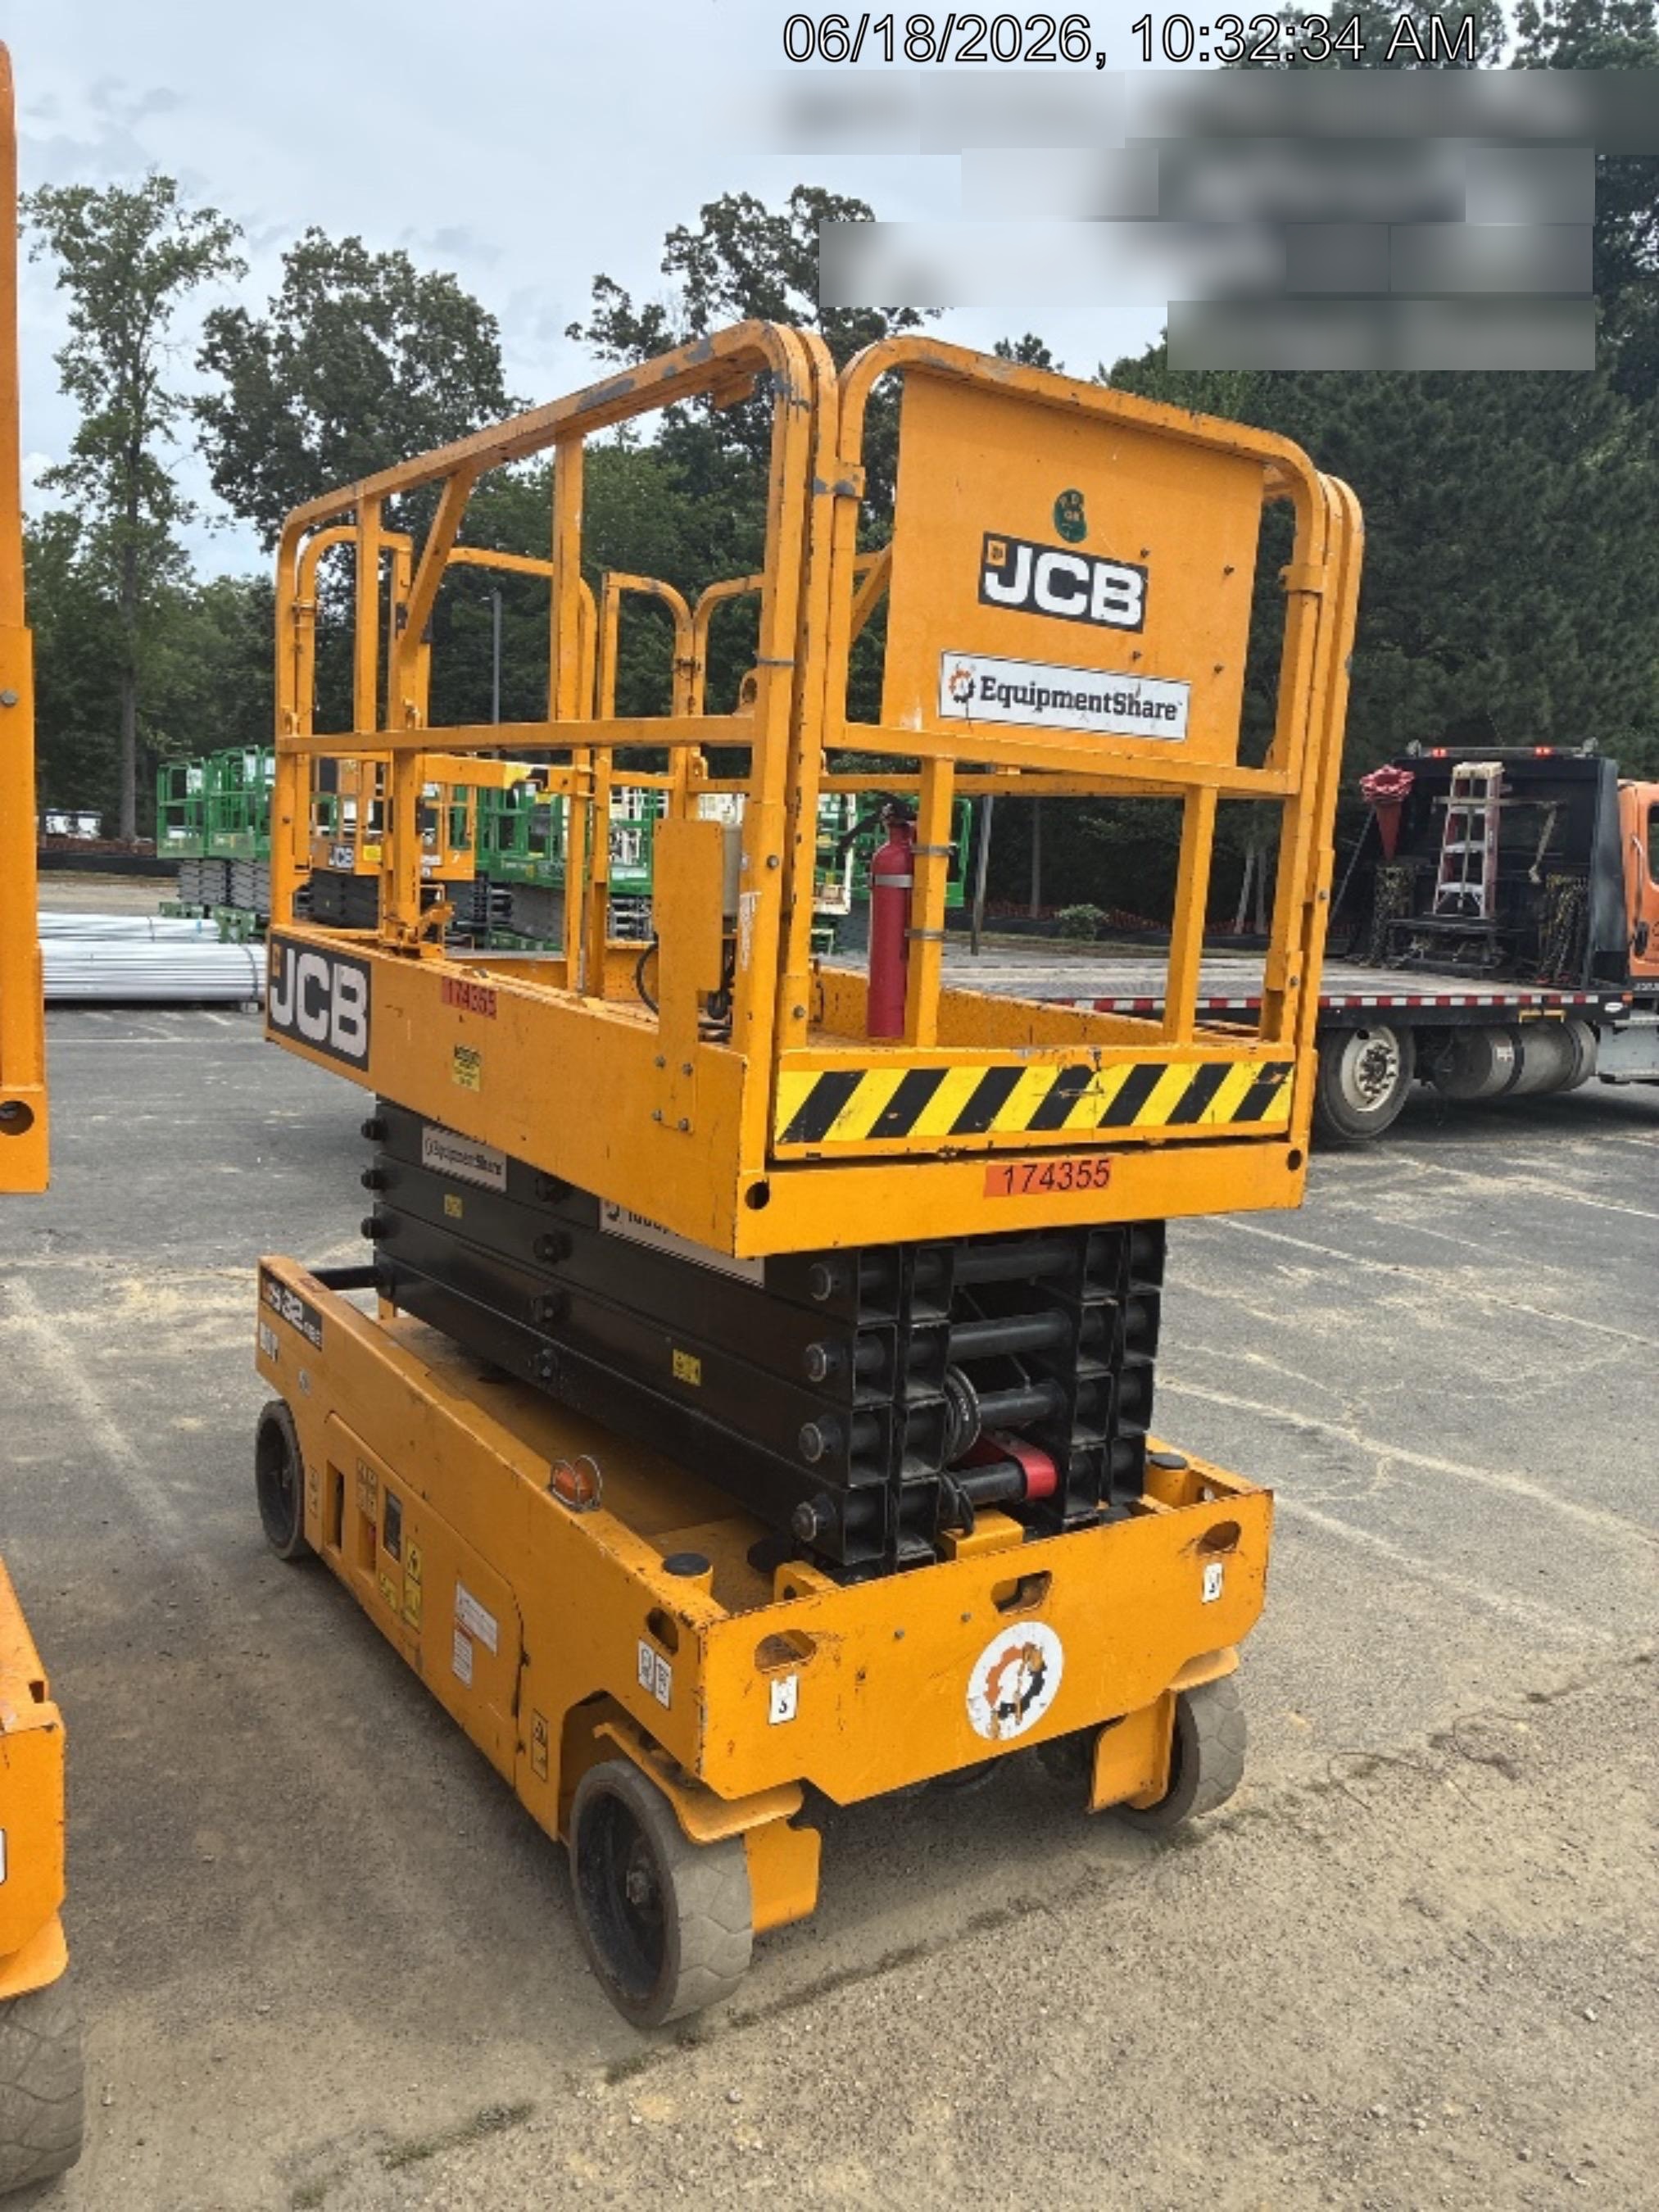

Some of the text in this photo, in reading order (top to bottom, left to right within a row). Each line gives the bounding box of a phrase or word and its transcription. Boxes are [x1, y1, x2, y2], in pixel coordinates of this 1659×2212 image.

[986, 546, 1144, 625] JCB
[981, 676, 1177, 720] EquipmentShare
[270, 948, 367, 1057] JCB
[1003, 1160, 1110, 1195] 174355
